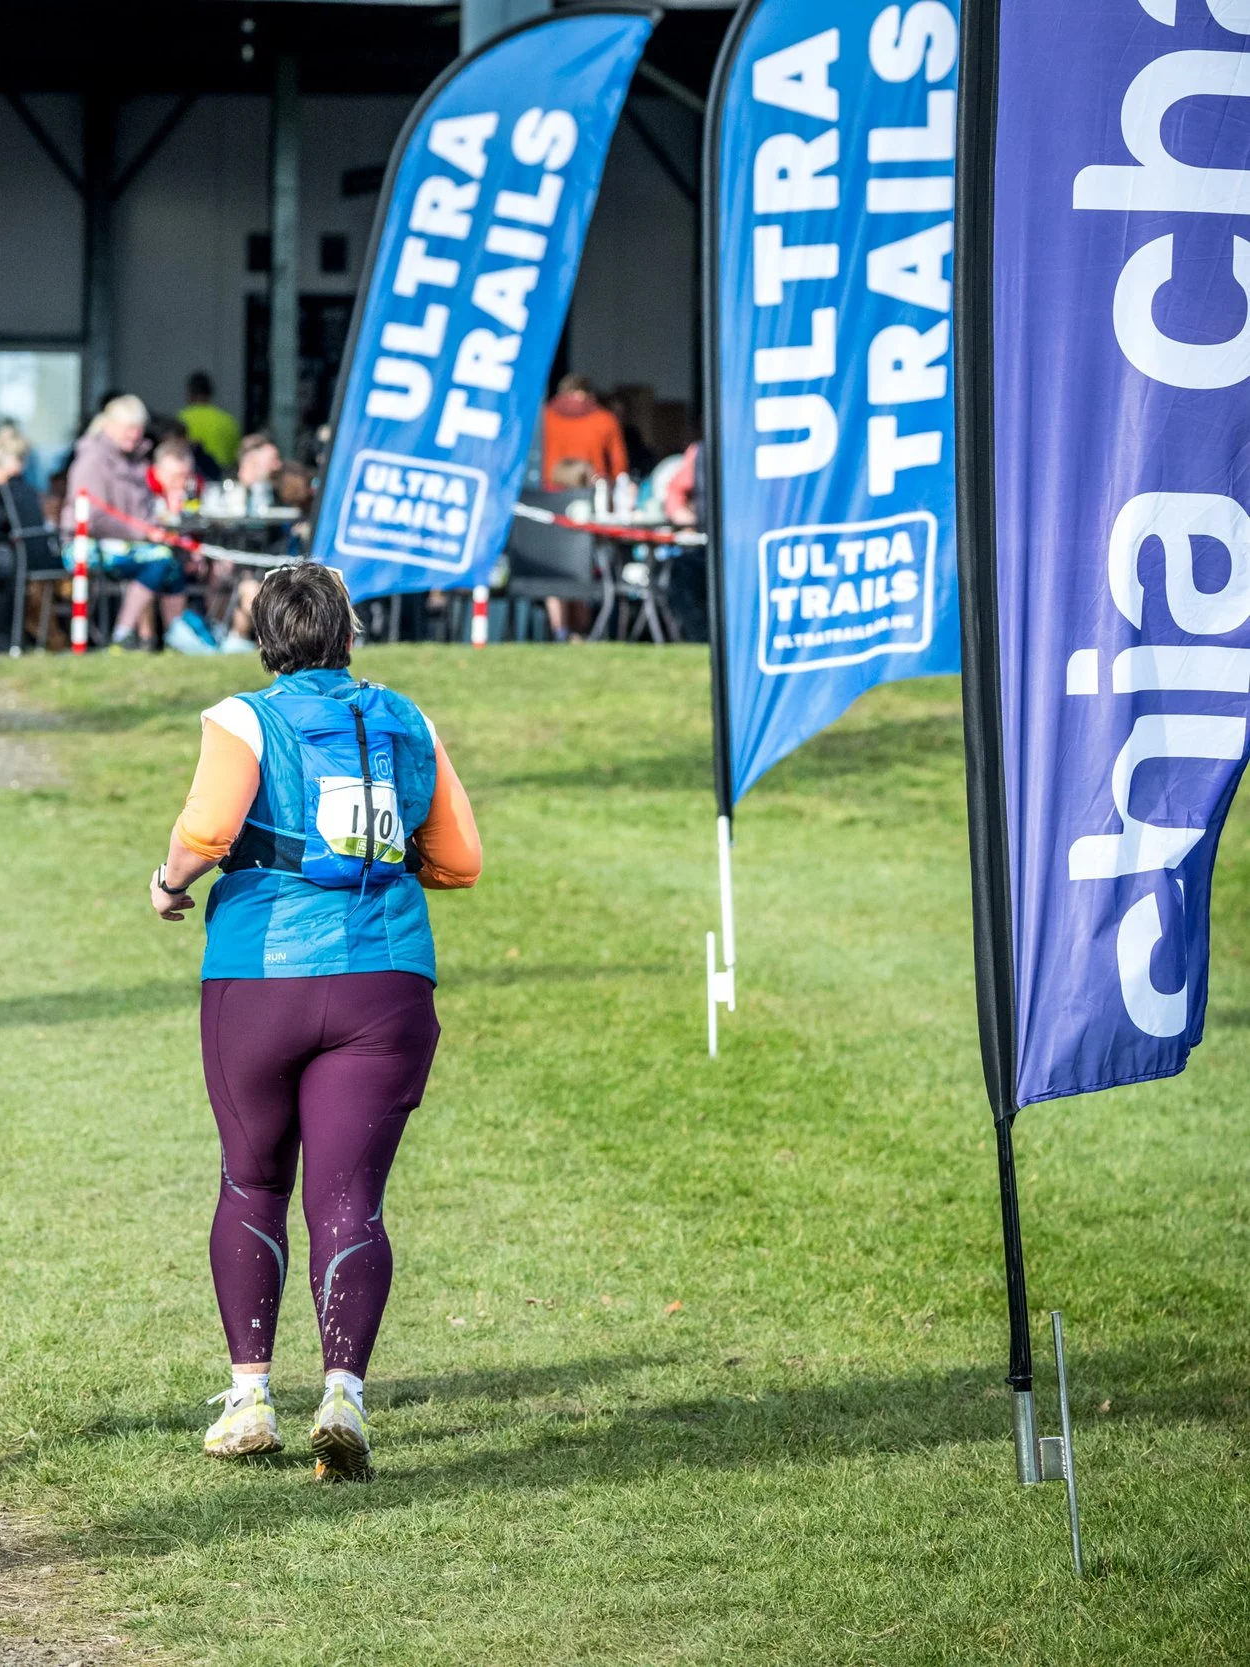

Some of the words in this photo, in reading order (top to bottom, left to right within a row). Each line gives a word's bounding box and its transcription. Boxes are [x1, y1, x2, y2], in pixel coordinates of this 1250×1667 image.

[366, 111, 498, 421] ULTRA
[435, 108, 578, 448] TRAILS
[752, 28, 840, 479] ULTRA
[867, 1, 959, 497] TRAILS
[1073, 0, 1250, 390] ch
[355, 491, 468, 535] TRAILS
[364, 464, 467, 507] ULTRA
[778, 531, 914, 579] ULTRA
[770, 570, 918, 622] TRAILS
[265, 952, 286, 961] RUN
